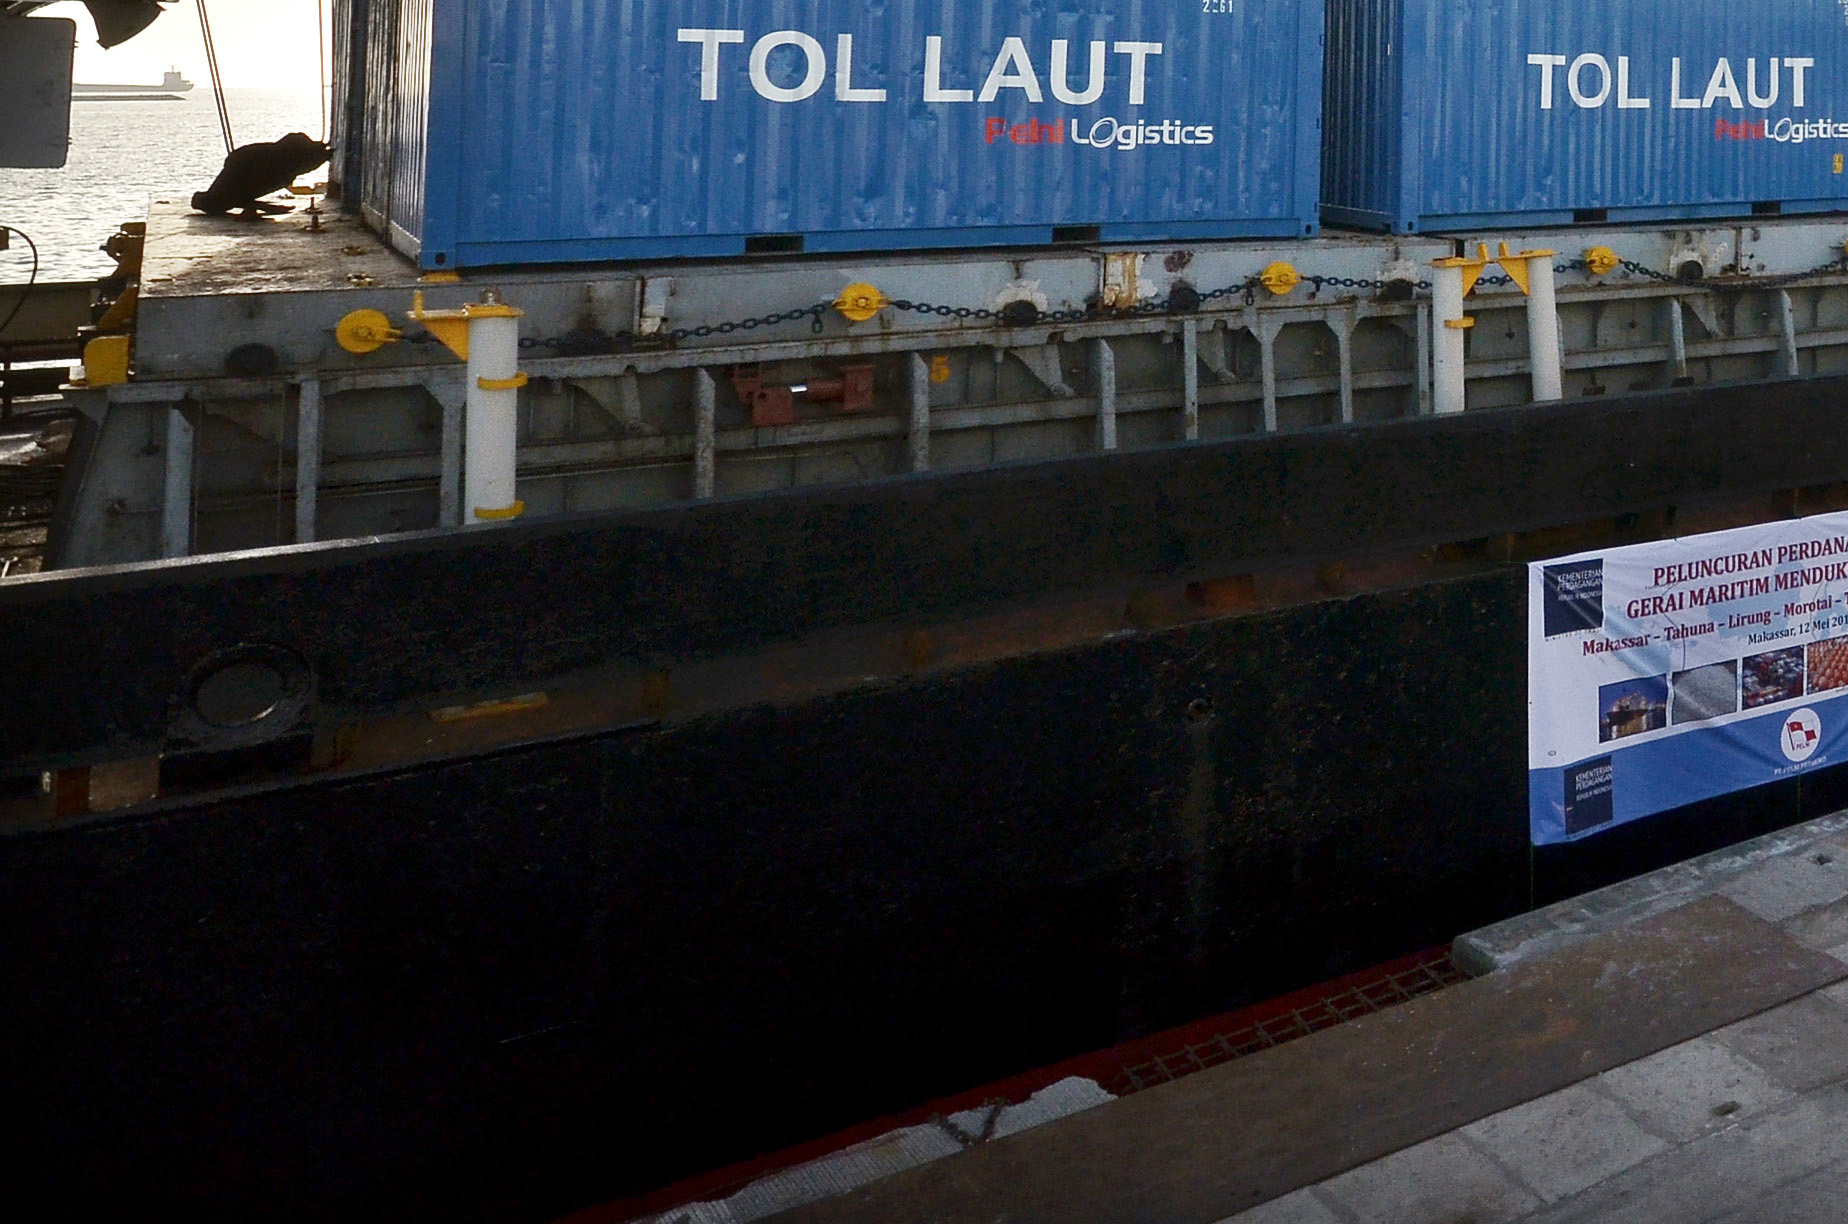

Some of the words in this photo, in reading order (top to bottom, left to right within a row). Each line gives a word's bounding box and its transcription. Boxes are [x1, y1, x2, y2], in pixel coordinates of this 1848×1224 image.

[676, 28, 888, 103] TOL
[922, 35, 1163, 106] LAUT
[1527, 52, 1651, 109] TOL
[1671, 56, 1815, 109] LAUT
[985, 116, 1065, 145] Pelni
[1653, 548, 1773, 587] PELUNCURAN
[1626, 591, 1684, 619] GERAI
[1689, 575, 1770, 608] MARITIM
[1582, 633, 1651, 656] Makassar
[1663, 621, 1715, 641] Tahuna
[1728, 610, 1771, 629] Lirung
[1783, 595, 1832, 617] Morotai
[1747, 628, 1796, 645] Makassar,
[1799, 620, 1811, 634] 12
[1812, 615, 1830, 631] Mei
